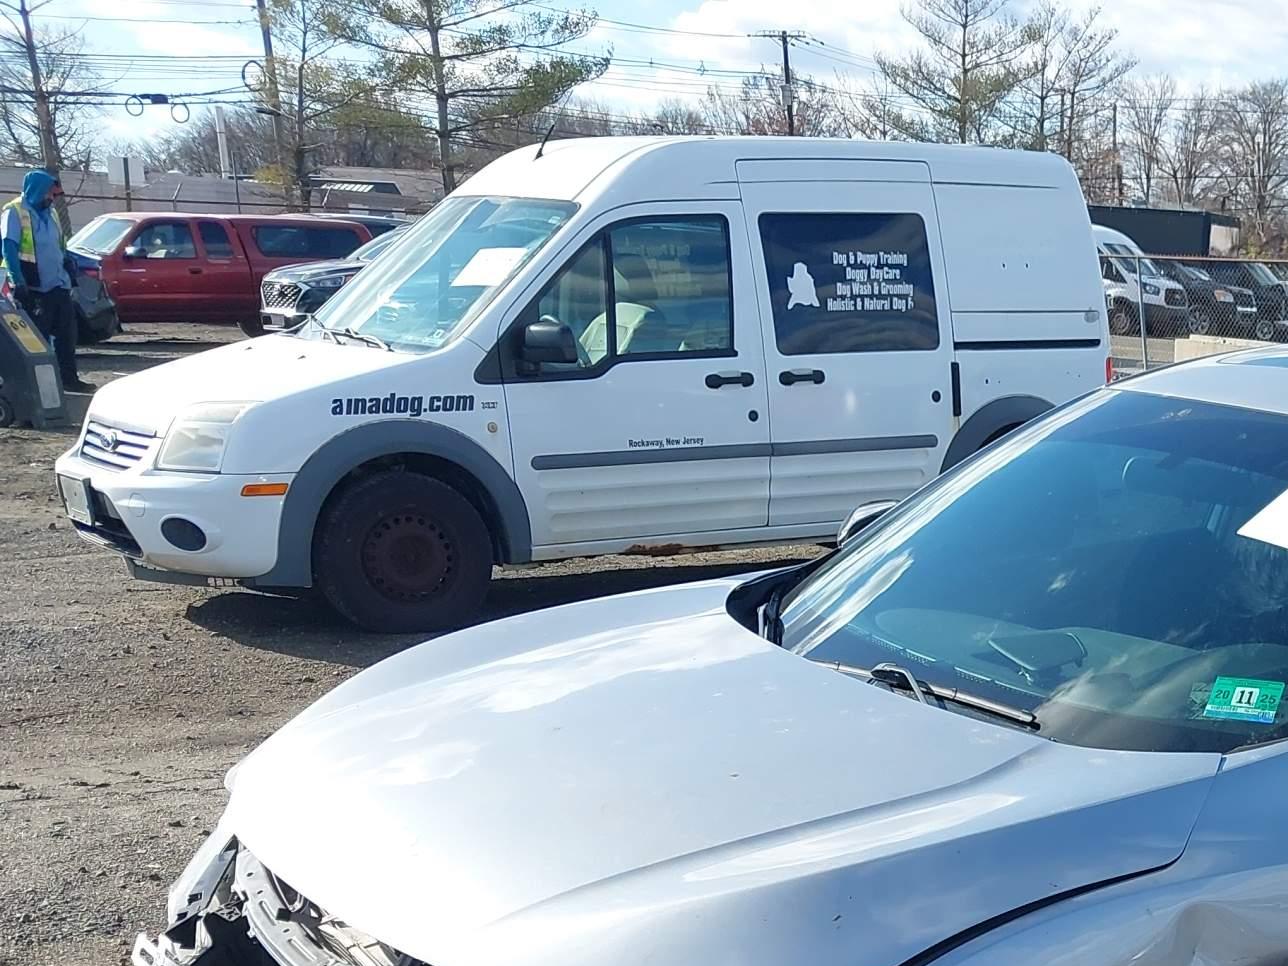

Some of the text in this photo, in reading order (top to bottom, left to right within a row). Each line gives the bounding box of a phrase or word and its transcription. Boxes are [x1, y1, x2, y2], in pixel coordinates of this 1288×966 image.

[833, 252, 907, 266] Dog & Puppy Training
[846, 267, 900, 281] Doggy DayCare
[836, 281, 913, 297] Dog Wash & Grooming
[827, 298, 855, 311] Holistic
[856, 297, 862, 311] &
[864, 297, 891, 311] Natural
[892, 297, 906, 312] Dog
[628, 437, 704, 448] Rockaway, New Jersey
[1215, 689, 1277, 705] 20 11 25
